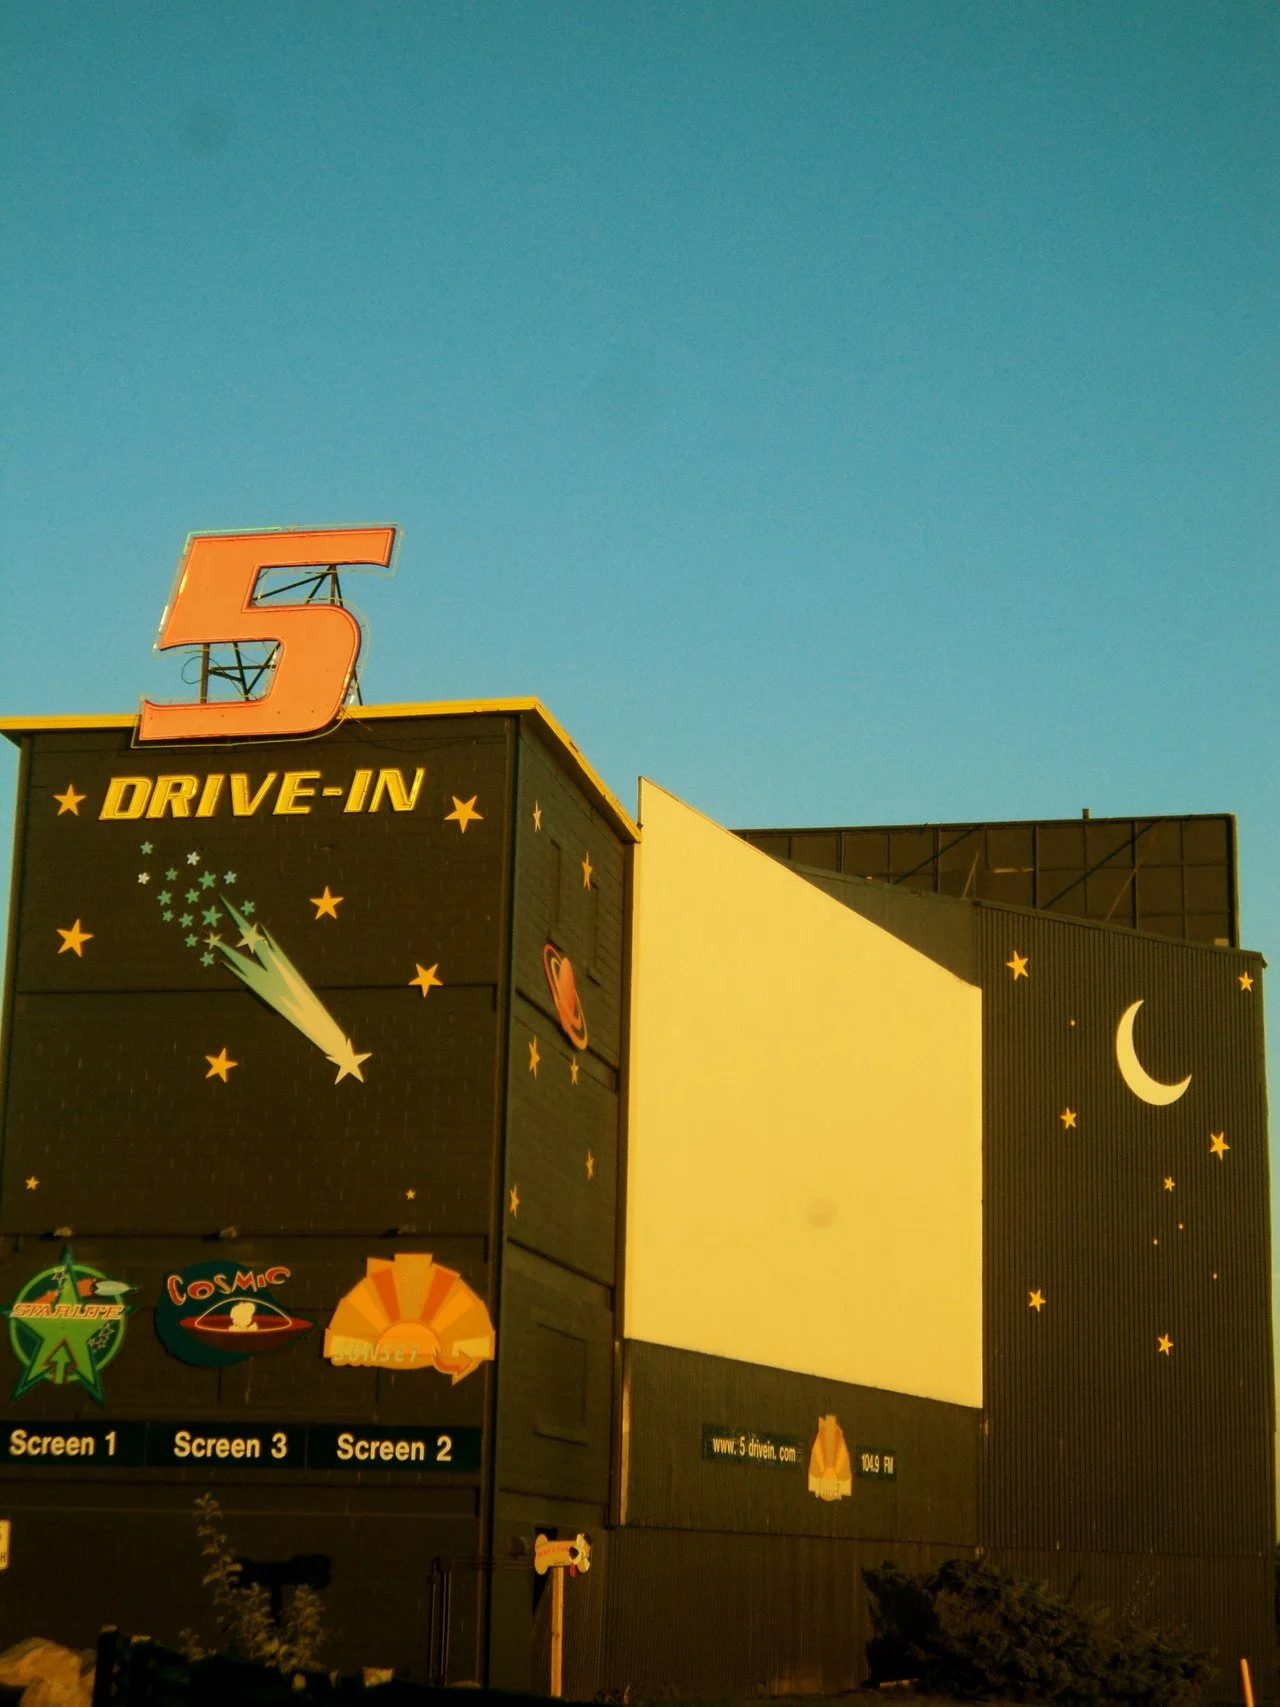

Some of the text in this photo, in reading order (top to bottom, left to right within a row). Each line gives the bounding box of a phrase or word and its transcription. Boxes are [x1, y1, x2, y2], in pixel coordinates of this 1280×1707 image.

[136, 525, 398, 742] 5
[99, 767, 425, 820] DRIVE-IN
[334, 1342, 420, 1364] SUNSET
[9, 1429, 117, 1457] Screen 1
[174, 1431, 288, 1459] Screen 3
[336, 1434, 452, 1461] Screen 2
